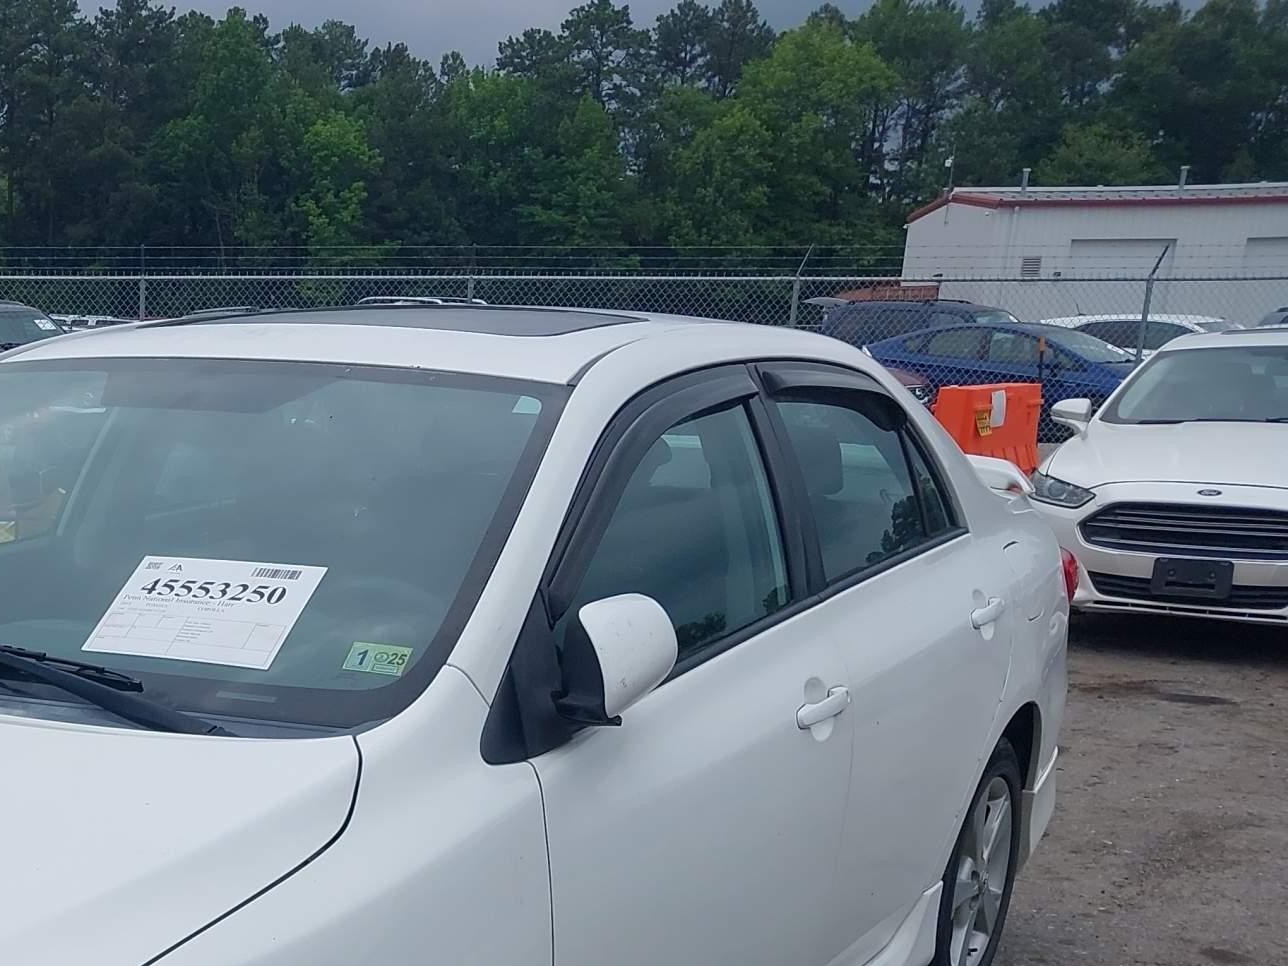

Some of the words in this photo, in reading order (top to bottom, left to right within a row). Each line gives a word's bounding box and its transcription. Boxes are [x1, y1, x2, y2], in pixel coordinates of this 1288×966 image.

[141, 578, 287, 605] 45553250
[143, 595, 175, 603] National
[176, 598, 211, 606] Insurance
[357, 649, 369, 666] 1
[386, 652, 408, 666] 25
